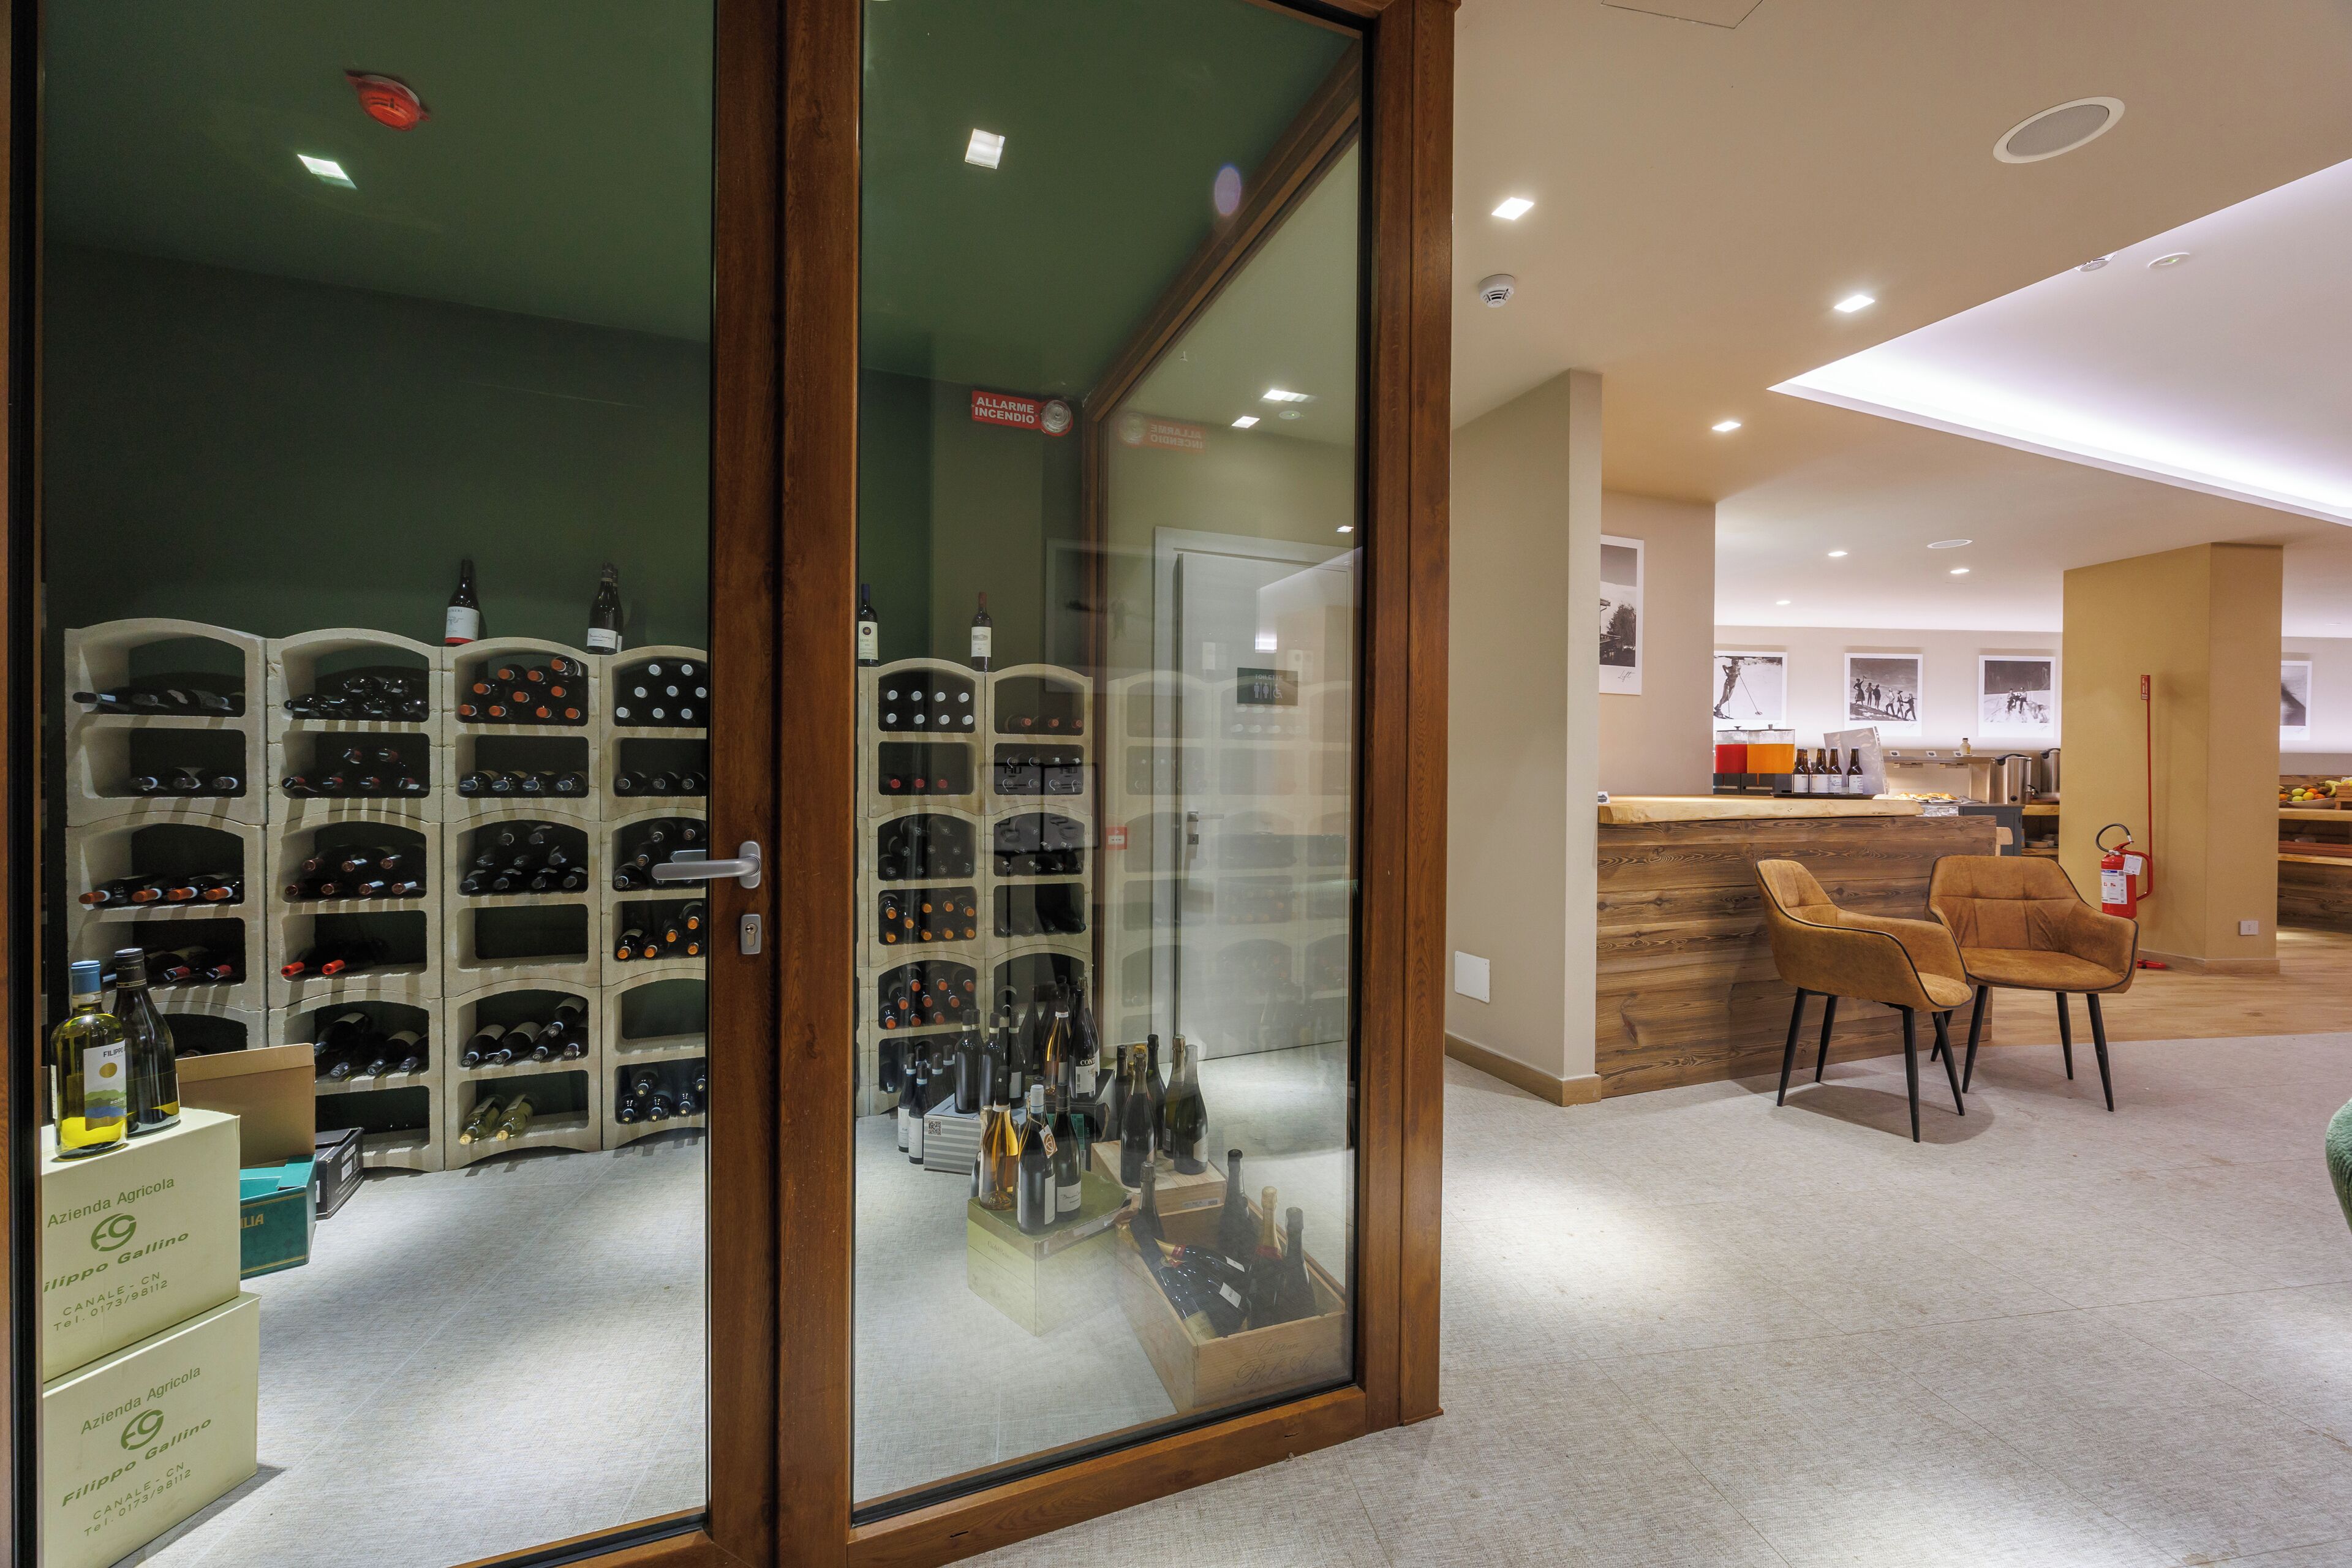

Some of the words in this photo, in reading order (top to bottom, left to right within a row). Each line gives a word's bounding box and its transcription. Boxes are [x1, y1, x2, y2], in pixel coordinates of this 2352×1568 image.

[974, 407, 1035, 424] INCENDIO
[976, 396, 1035, 413] ALLARME
[47, 1199, 111, 1227] Azienda
[117, 1178, 175, 1205] Agricola
[240, 1213, 264, 1229] ILIA
[43, 1263, 108, 1293] ilippo
[118, 1233, 189, 1264] Gallino
[53, 1316, 85, 1331] Tel.
[91, 1280, 168, 1316] 0173/98112
[63, 1285, 124, 1316] CANALE
[141, 1272, 160, 1285] CN
[81, 1397, 141, 1435] Azienda
[146, 1368, 201, 1401] Agricola
[62, 1461, 137, 1507] Filippo
[145, 1419, 211, 1460] Gallino
[84, 1518, 113, 1537] Tel.
[118, 1469, 191, 1517] 0173/98112
[93, 1481, 151, 1520] CANALE
[166, 1461, 184, 1477] CN
